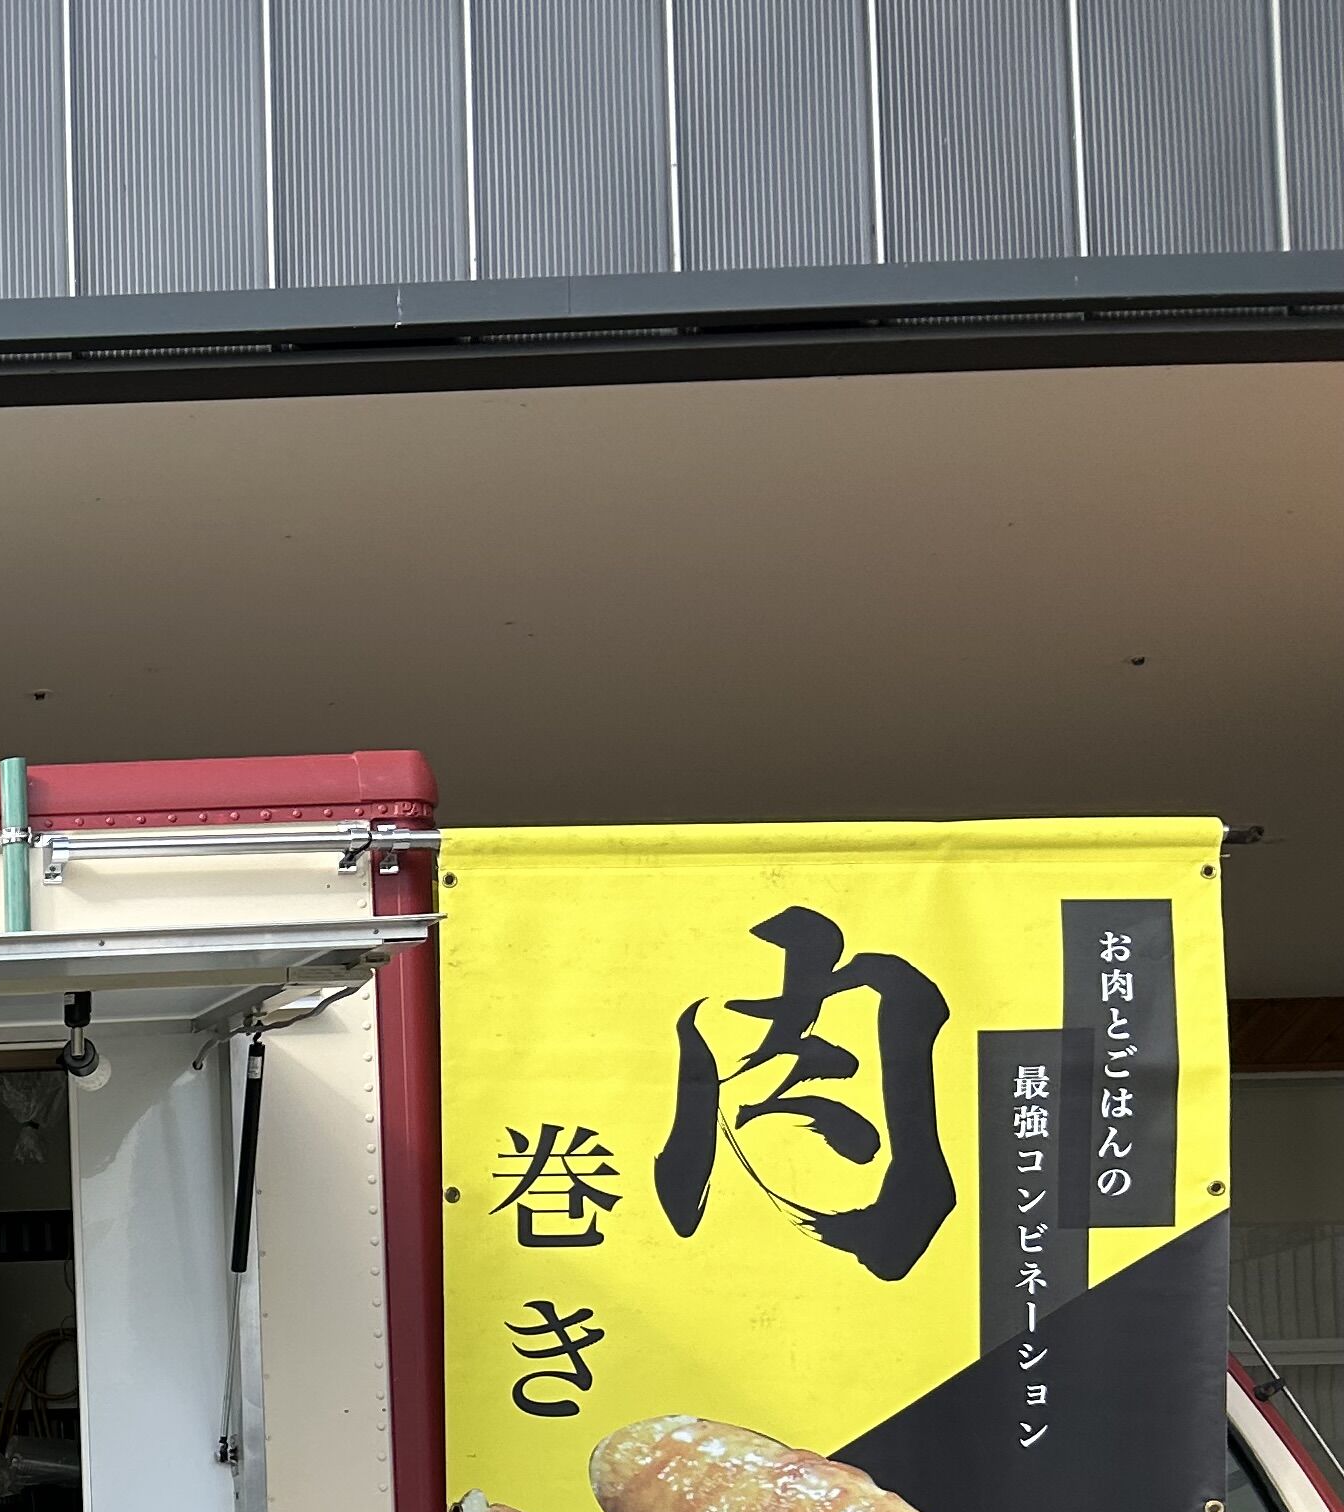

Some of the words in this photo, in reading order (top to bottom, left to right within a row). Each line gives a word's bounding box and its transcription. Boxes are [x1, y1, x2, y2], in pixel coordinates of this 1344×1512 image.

[654, 905, 957, 1282] 肉
[1095, 930, 1137, 1199] お肉とごはんの
[489, 1123, 624, 1418] 巻き
[1012, 1064, 1051, 1449] 最強コンビネーション
